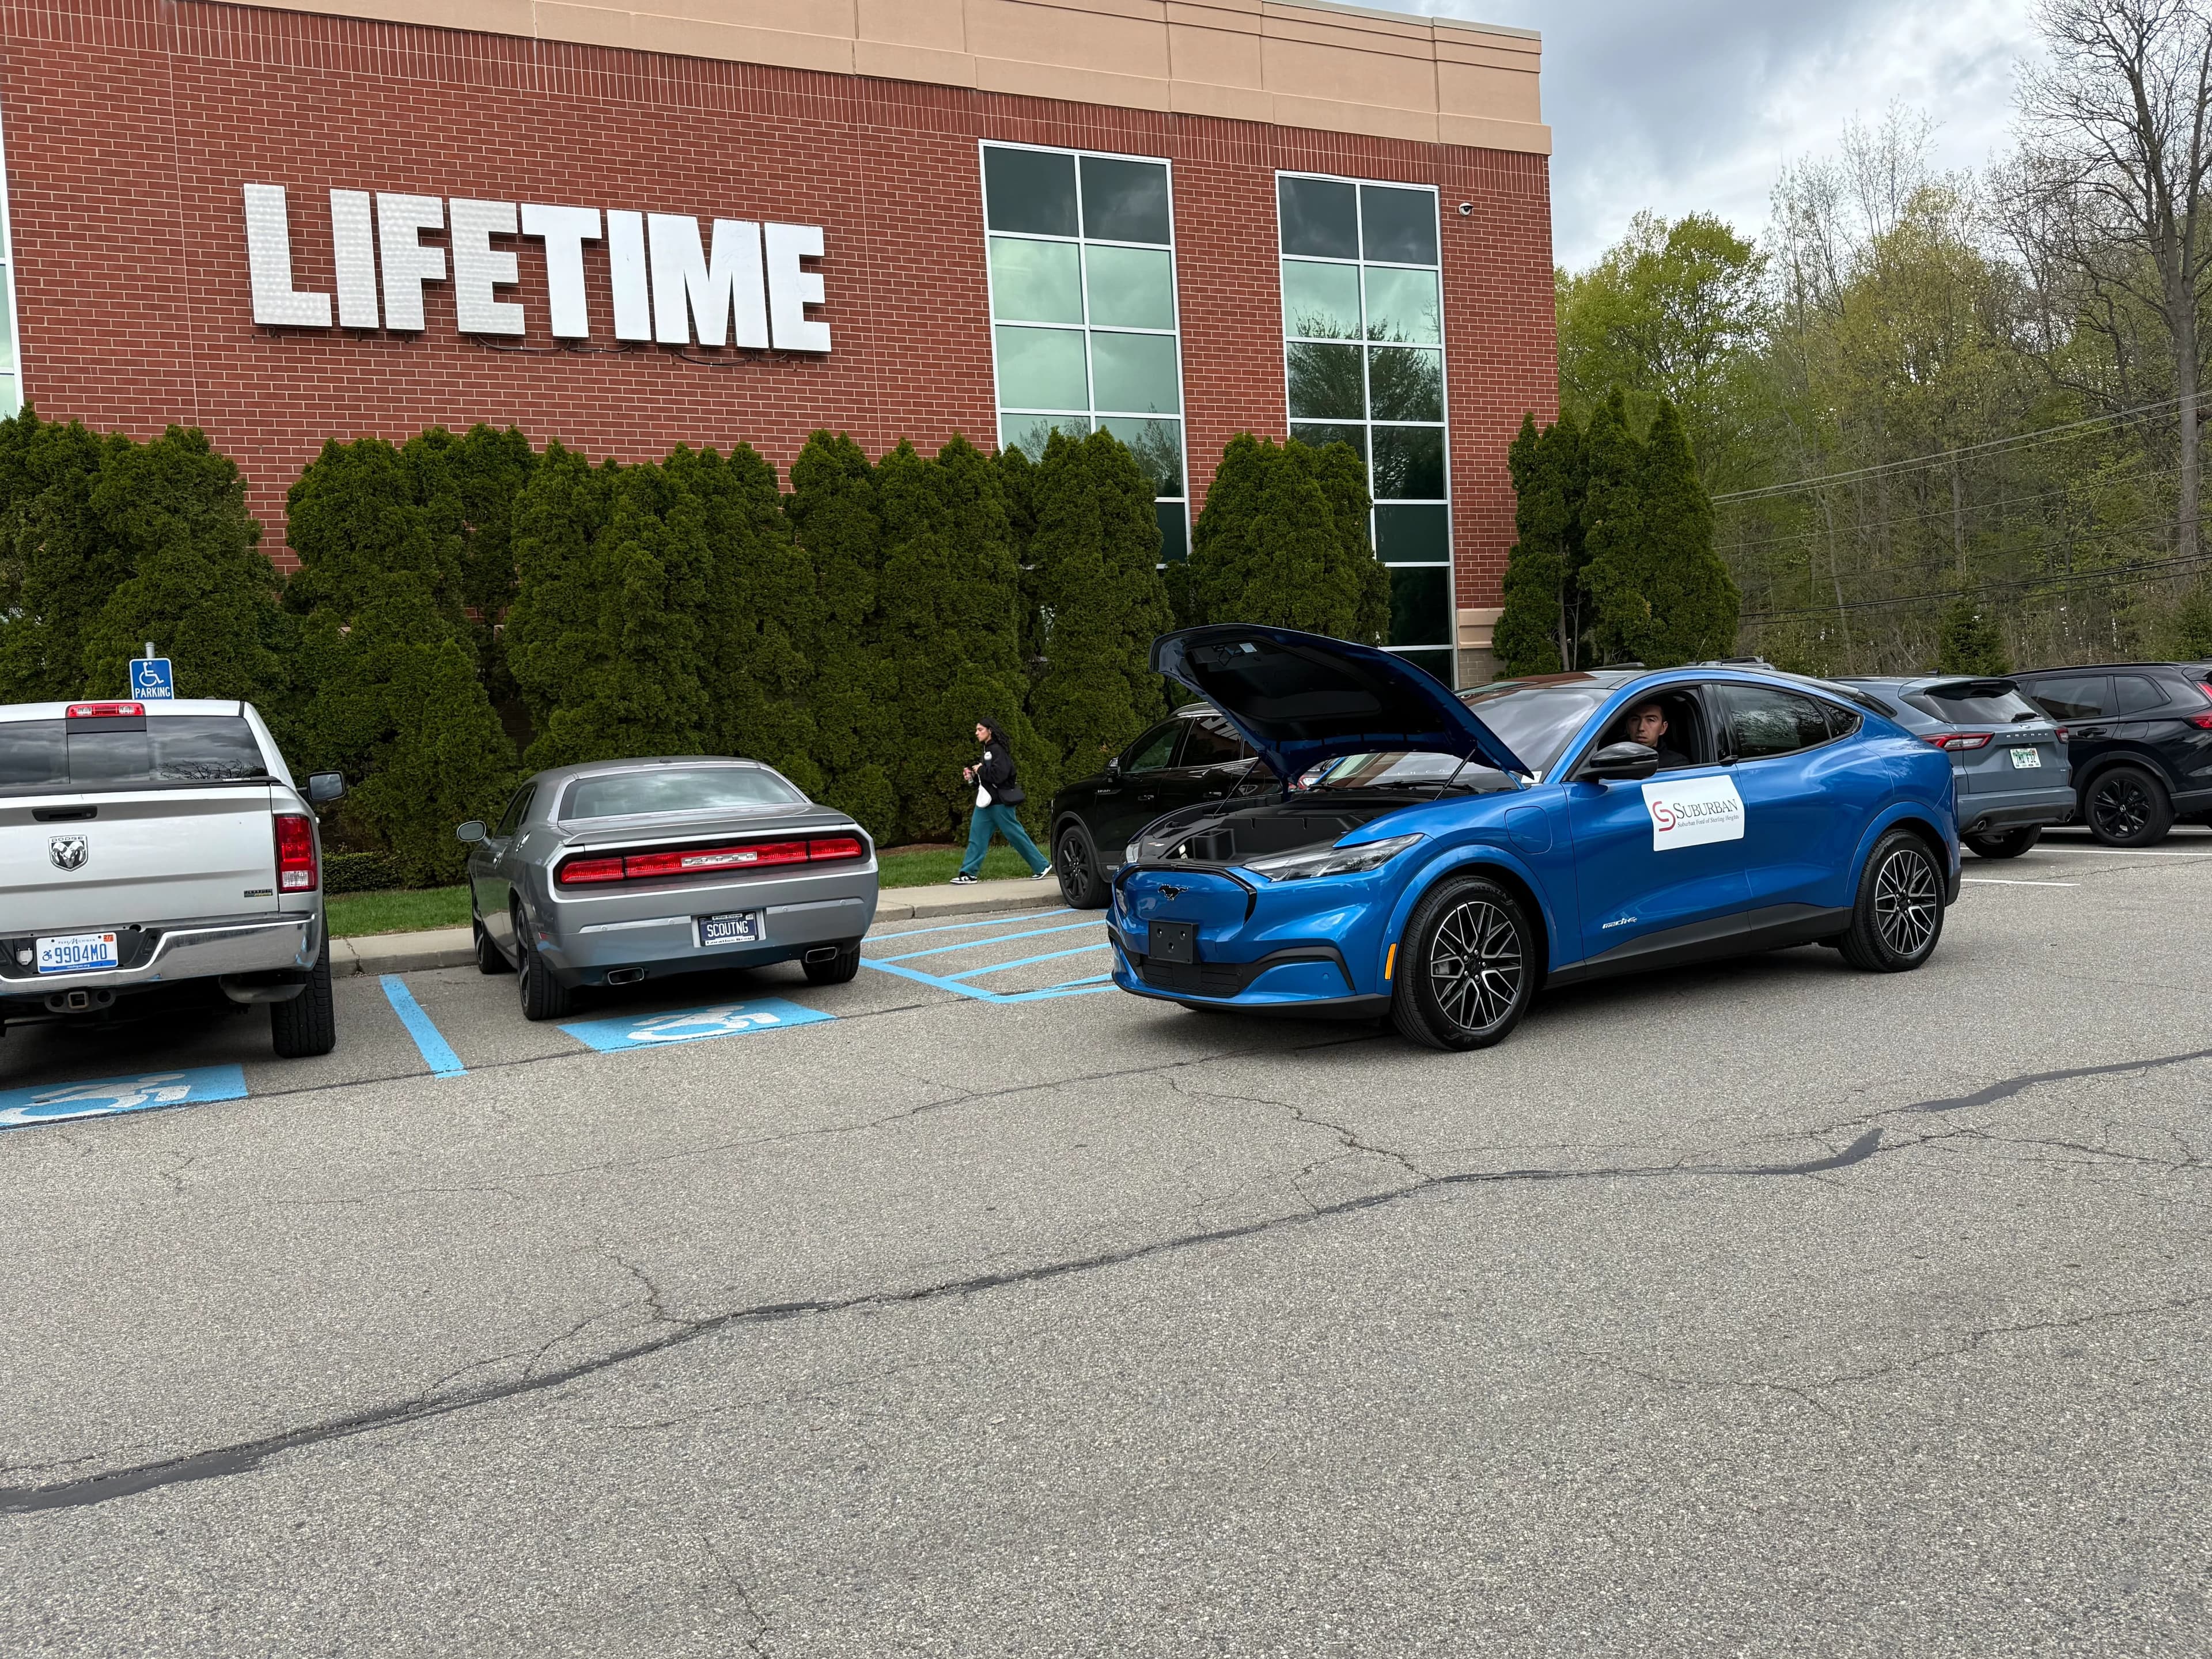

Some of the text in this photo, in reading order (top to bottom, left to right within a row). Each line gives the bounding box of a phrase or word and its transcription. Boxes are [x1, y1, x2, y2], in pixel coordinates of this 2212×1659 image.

[244, 183, 831, 353] LIFETIME
[135, 687, 171, 698] PARKING
[1673, 799, 1738, 819] SUBURBAN
[707, 921, 748, 937] SCOUTNG
